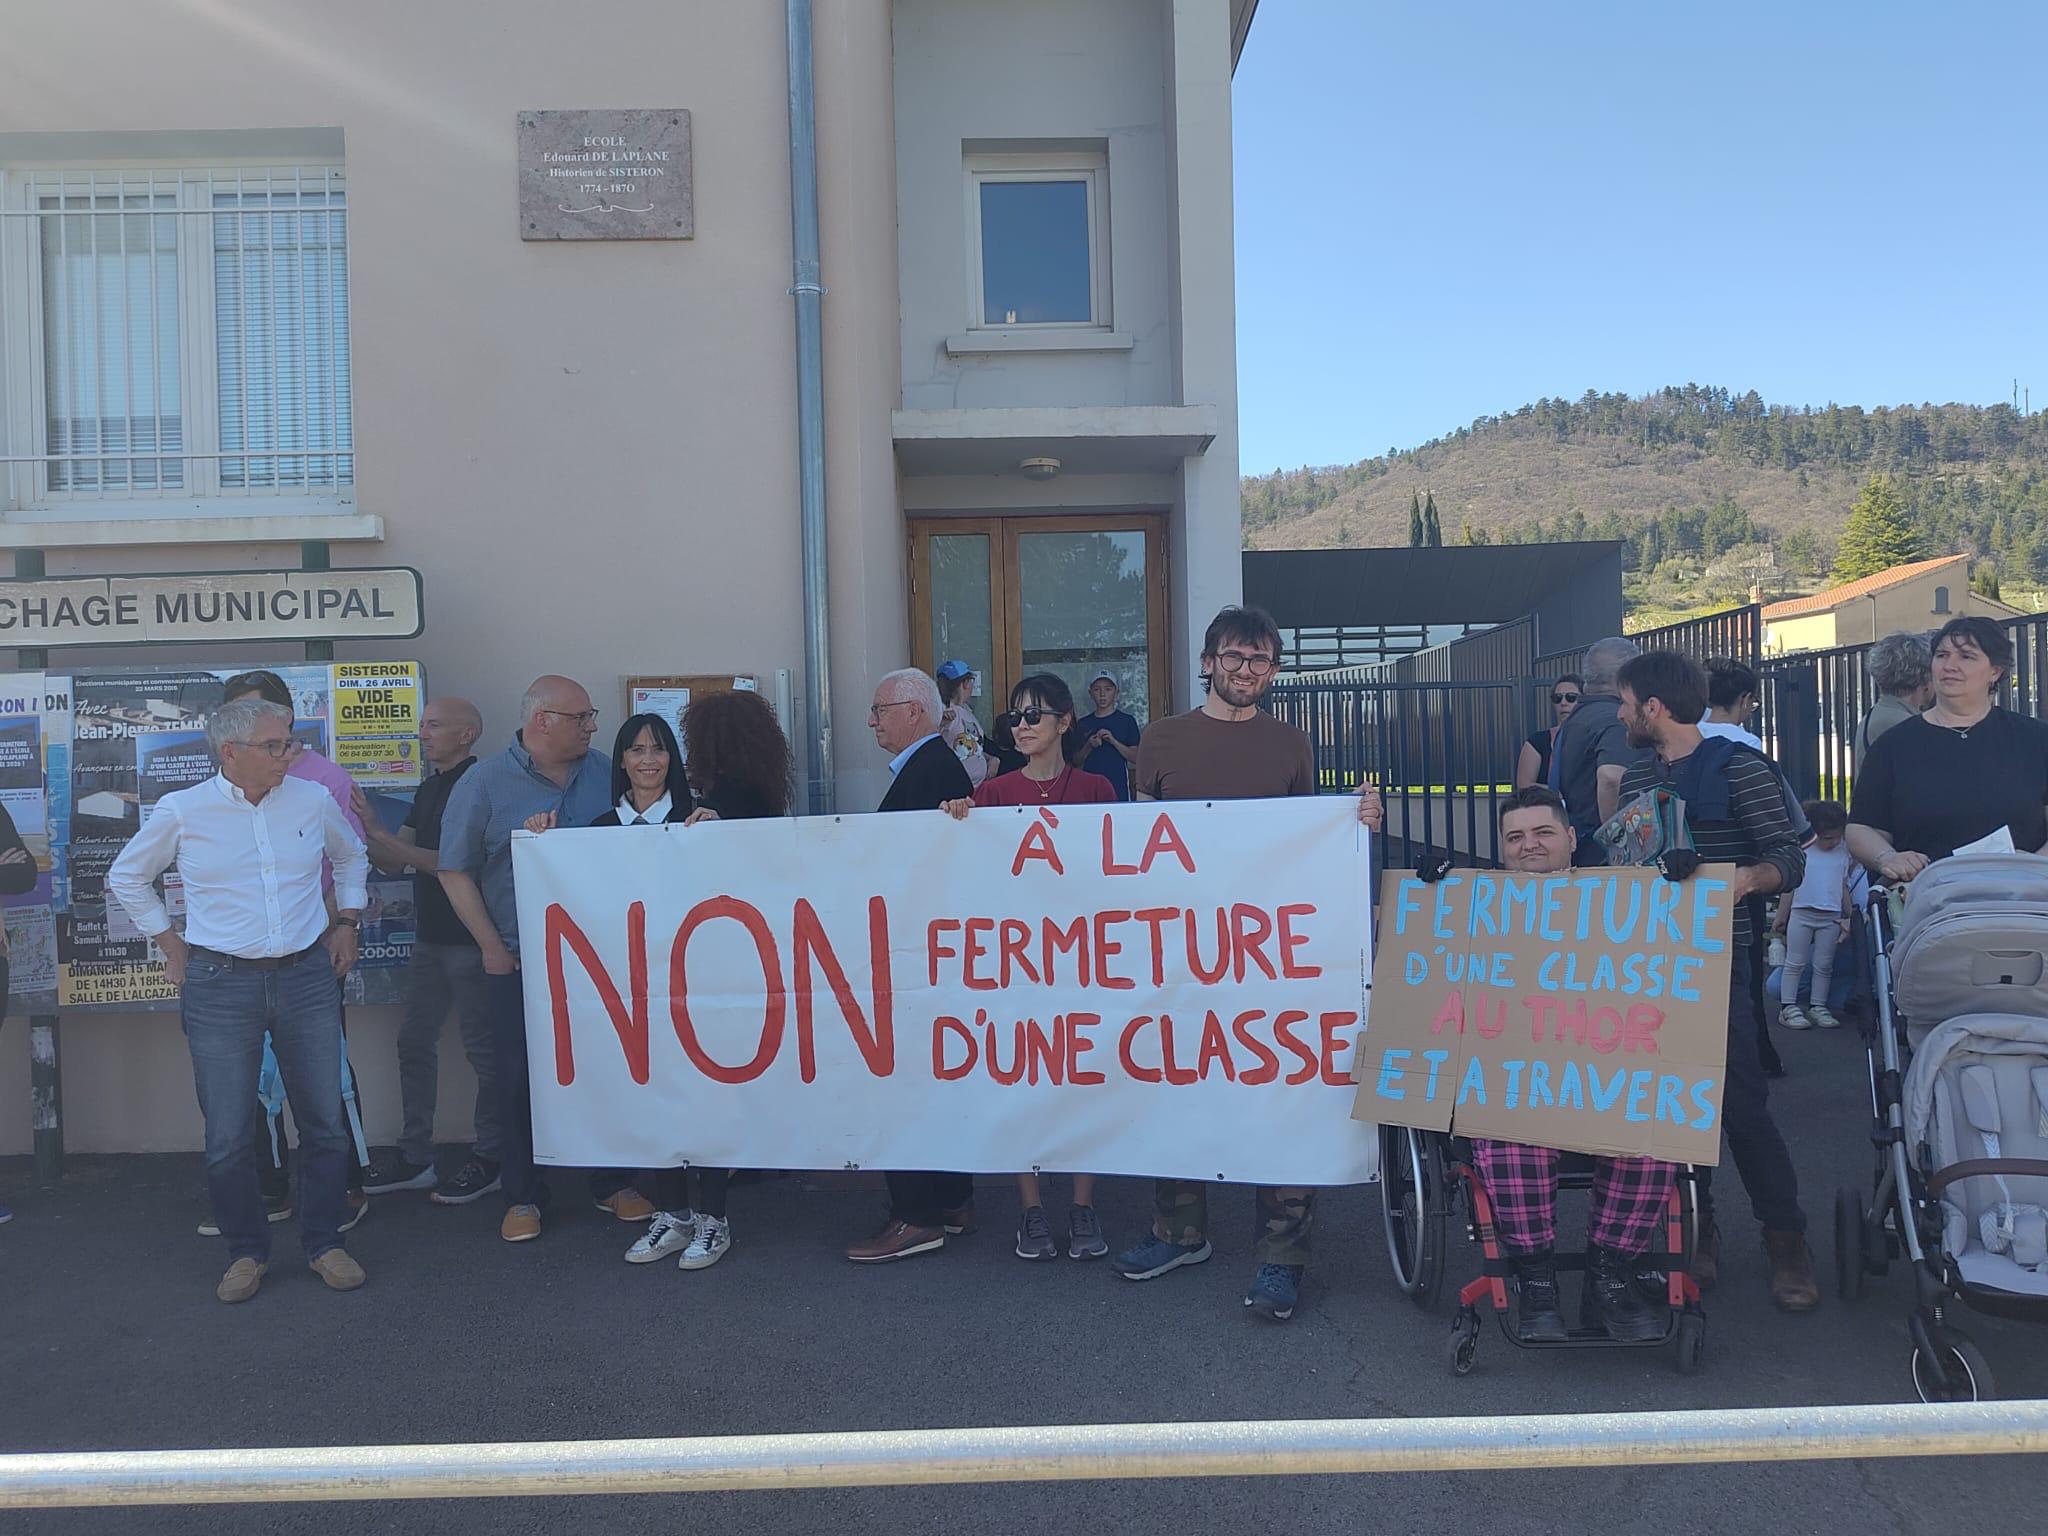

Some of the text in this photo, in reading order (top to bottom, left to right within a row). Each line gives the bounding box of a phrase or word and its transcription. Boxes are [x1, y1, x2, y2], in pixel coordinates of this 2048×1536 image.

[584, 137, 626, 147] ECOLE
[544, 152, 670, 162] Edouard DE LAPLANE
[550, 168, 664, 177] Historien de SISTERON
[580, 184, 600, 193] 1774
[611, 184, 635, 193] 1870
[156, 588, 395, 624] MUNICIPAL
[340, 665, 409, 676] SISTERON
[366, 679, 378, 687] 26
[357, 690, 393, 703] VIDE
[0, 697, 25, 713] ON
[75, 699, 108, 715] Avec
[342, 705, 411, 719] GRENIER
[1011, 806, 1197, 877] À LA
[1395, 875, 1728, 953] FERMETURE
[77, 922, 100, 932] Buffet
[74, 934, 102, 945] Samedi
[928, 902, 1323, 989] FERMETURE
[105, 947, 127, 956] 11h30
[69, 964, 126, 977] DIMANCHE
[131, 964, 143, 974] 15
[1405, 945, 1704, 1002] D'UNE CLASSE
[76, 981, 90, 990] DE
[95, 978, 125, 989] 14H30
[129, 974, 137, 987] À
[69, 992, 103, 1003] SALLE
[106, 991, 120, 1001] DE
[545, 895, 895, 1086] NON
[1432, 991, 1665, 1056] AU THOR
[933, 1008, 1359, 1087] D'UNE CLASSE
[1376, 1048, 1449, 1102] ET
[1503, 1060, 1716, 1131] TRAVERS
